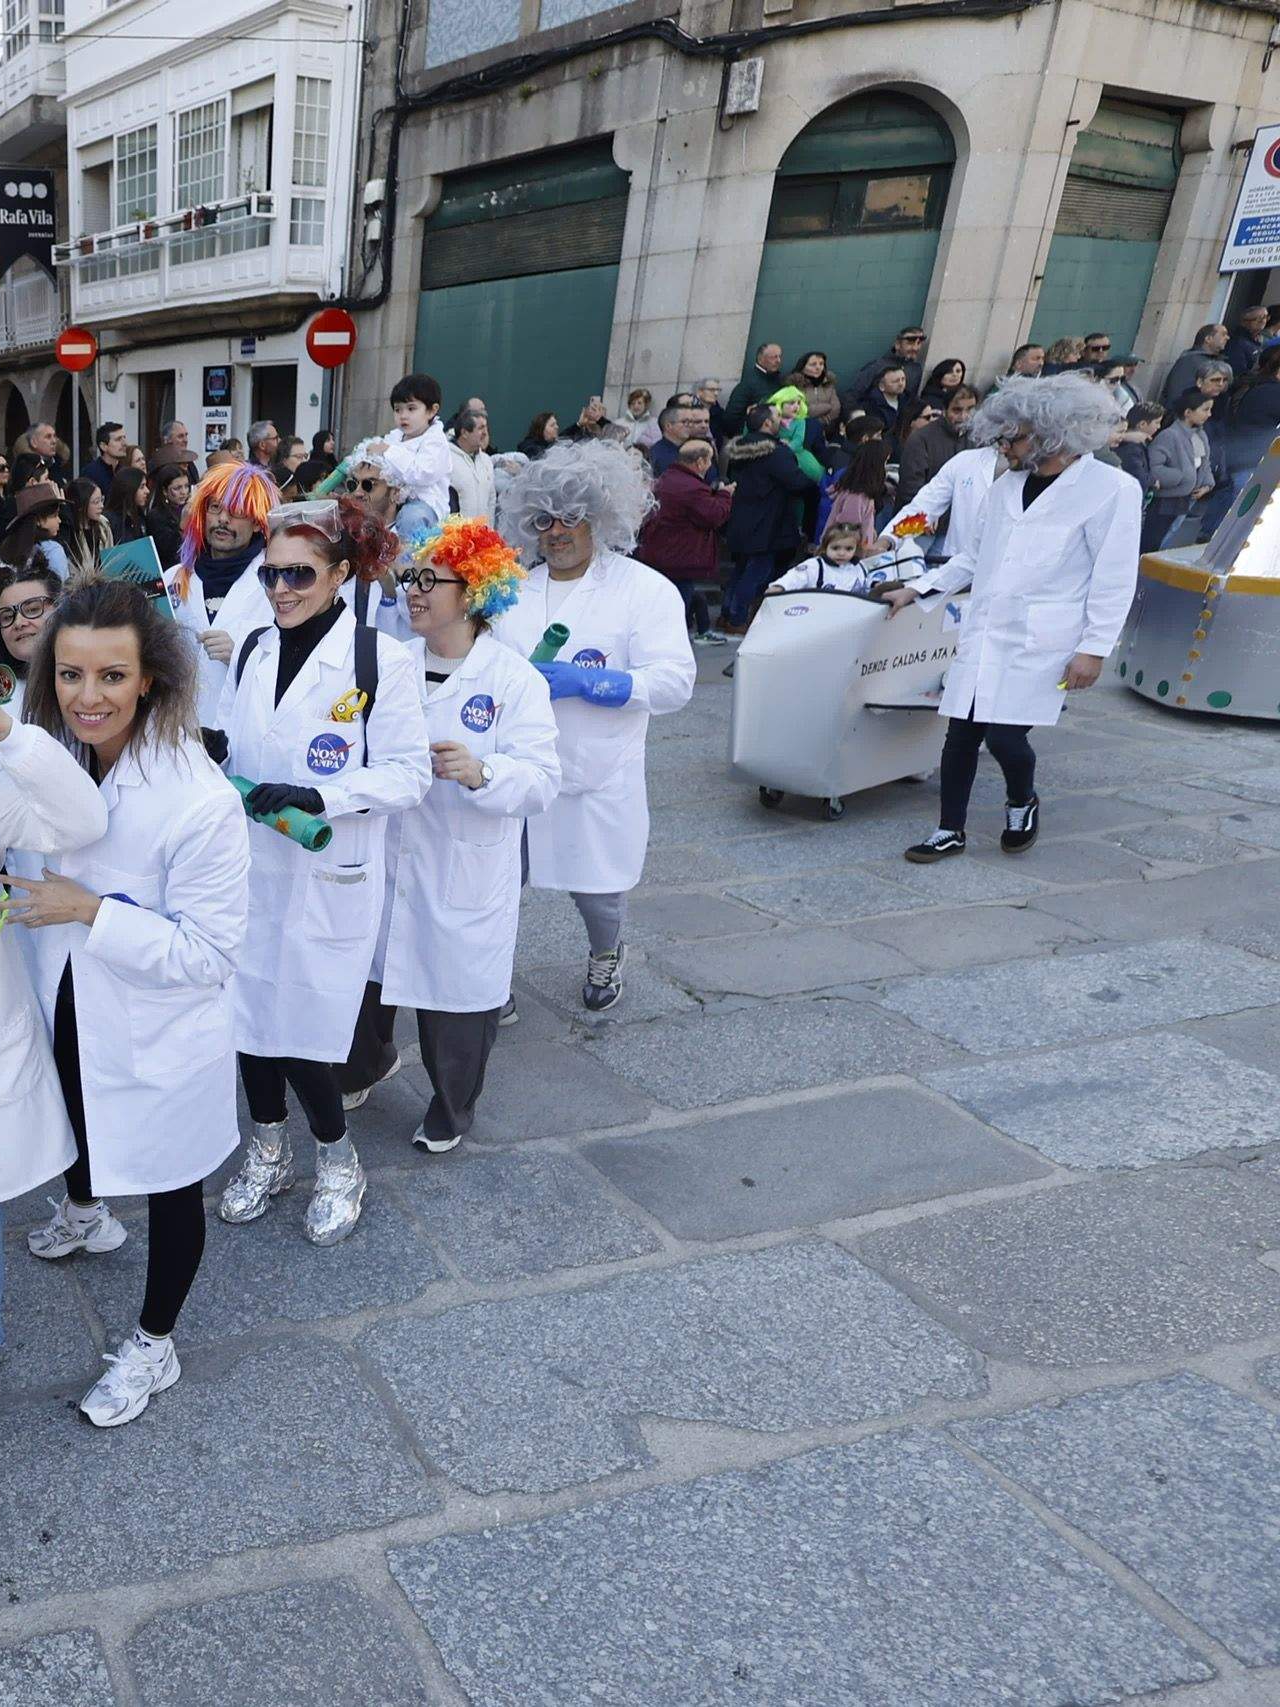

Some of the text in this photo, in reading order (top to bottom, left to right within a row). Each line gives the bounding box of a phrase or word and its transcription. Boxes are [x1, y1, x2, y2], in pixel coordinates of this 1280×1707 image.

[0, 208, 53, 225] Rafa Vila
[1229, 255, 1265, 265] CONTROL
[861, 659, 888, 677] DENDE
[892, 650, 927, 669] CALDAS
[931, 646, 948, 661] ATA
[308, 748, 346, 762] NOSA
[311, 758, 340, 769] ANPA
